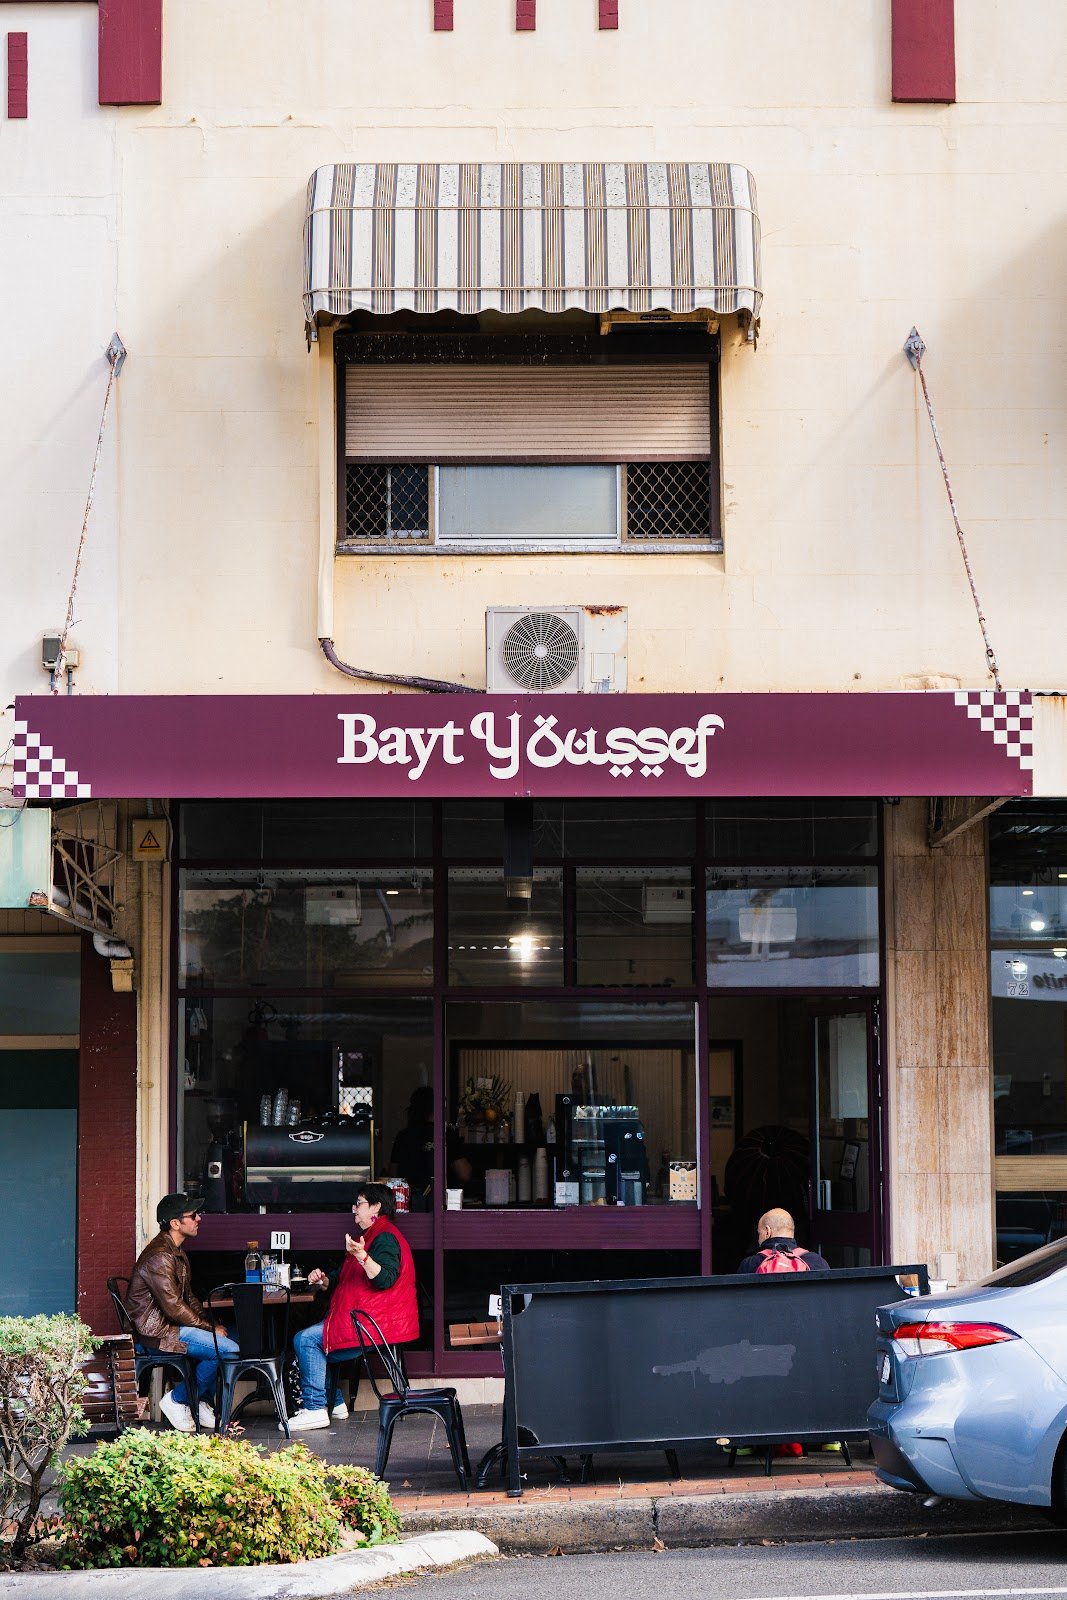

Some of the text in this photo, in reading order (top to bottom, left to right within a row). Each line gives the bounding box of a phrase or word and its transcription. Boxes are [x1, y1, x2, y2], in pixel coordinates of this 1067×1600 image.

[337, 713, 464, 780] Bayt
[1008, 982, 1029, 996] 72
[275, 1233, 286, 1245] 10
